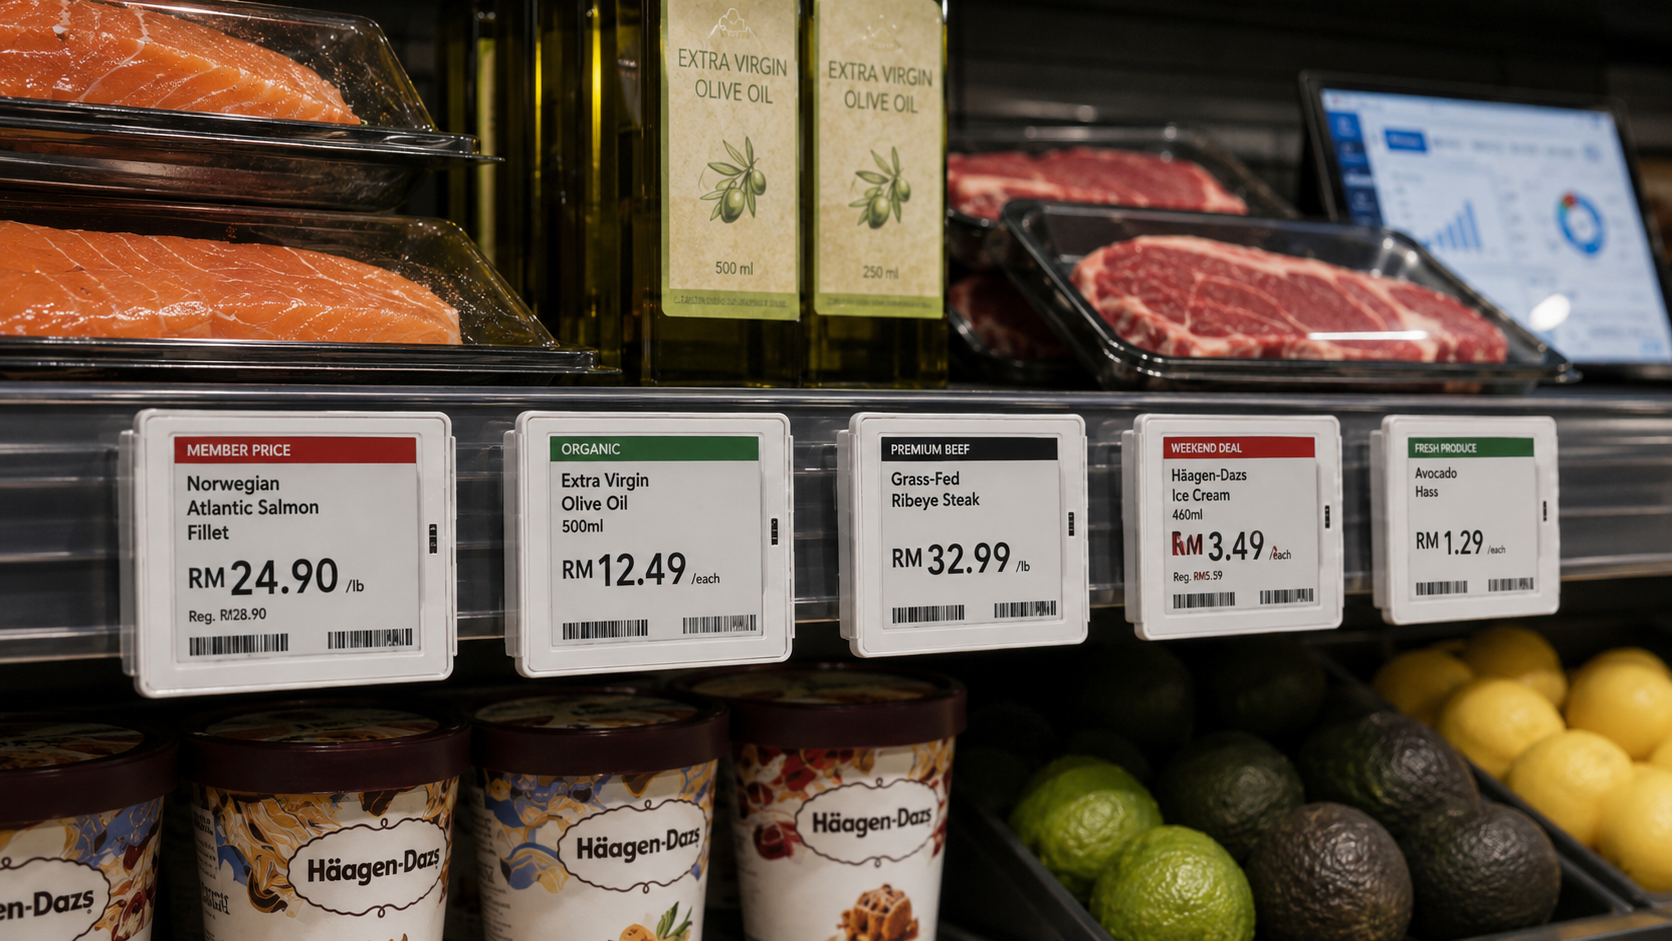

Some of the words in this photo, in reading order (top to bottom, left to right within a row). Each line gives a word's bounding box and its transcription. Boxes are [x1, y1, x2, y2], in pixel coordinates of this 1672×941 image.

[677, 48, 730, 72] EXTRA
[734, 53, 787, 77] VIRGIN
[828, 60, 878, 83] EXTRA
[882, 65, 933, 87] VIRGIN
[694, 78, 743, 102] OLIVE
[747, 84, 773, 104] OIL
[843, 90, 889, 112] OLIVE
[893, 94, 919, 114] OIL
[715, 261, 737, 275] 500
[739, 262, 754, 276] ml
[862, 265, 883, 279] 250
[885, 267, 899, 280] ml
[187, 443, 248, 457] MEMBER
[252, 443, 291, 457] PRICE
[561, 443, 621, 456] ORGANIC
[891, 444, 942, 455] PREMIUM
[945, 443, 970, 455] BEEF
[1171, 443, 1217, 453] WEEKEND
[1219, 443, 1242, 453] DEAL
[1415, 443, 1439, 453] FRESH
[1441, 443, 1477, 453] PRODUCE
[891, 471, 959, 486] Grass-Fed
[1172, 468, 1247, 485] Häagen-Dazs
[1415, 467, 1457, 479] Avocado
[187, 475, 280, 495] Norwegian
[561, 473, 601, 488] Extra
[604, 472, 649, 491] Virgin
[1172, 489, 1189, 502] Ice
[1192, 489, 1230, 501] Cream
[1415, 486, 1438, 497] Hass
[187, 499, 253, 516] Atlantic
[258, 499, 319, 514] Salmon
[561, 495, 602, 511] Olive
[606, 495, 628, 510] Oil
[891, 493, 939, 510] Ribeye
[942, 492, 980, 506] Steak
[1172, 508, 1203, 520] 460ml
[187, 524, 230, 540] Fillet
[562, 519, 603, 533] 500ml
[1172, 531, 1203, 556] RM
[1208, 530, 1264, 561] 3.49
[1416, 532, 1439, 549] RM
[1444, 530, 1483, 555] 1.29
[1487, 545, 1506, 555] /each
[892, 548, 922, 568] RM
[927, 542, 1011, 575] 32.99
[1015, 560, 1030, 573] /lb
[188, 567, 225, 589] RM
[230, 558, 338, 596] 24.90
[345, 579, 364, 594] /lb
[562, 560, 593, 579] RM
[598, 552, 686, 587] 12.49
[691, 573, 720, 585] /each
[1173, 572, 1192, 584] Reg.
[1193, 570, 1223, 581] RM5.59
[188, 610, 216, 625] Reg.
[812, 807, 932, 838] Häagen-Dazs
[576, 826, 700, 863] Häagen-Dazs
[307, 846, 440, 887] Häagen-Dazs
